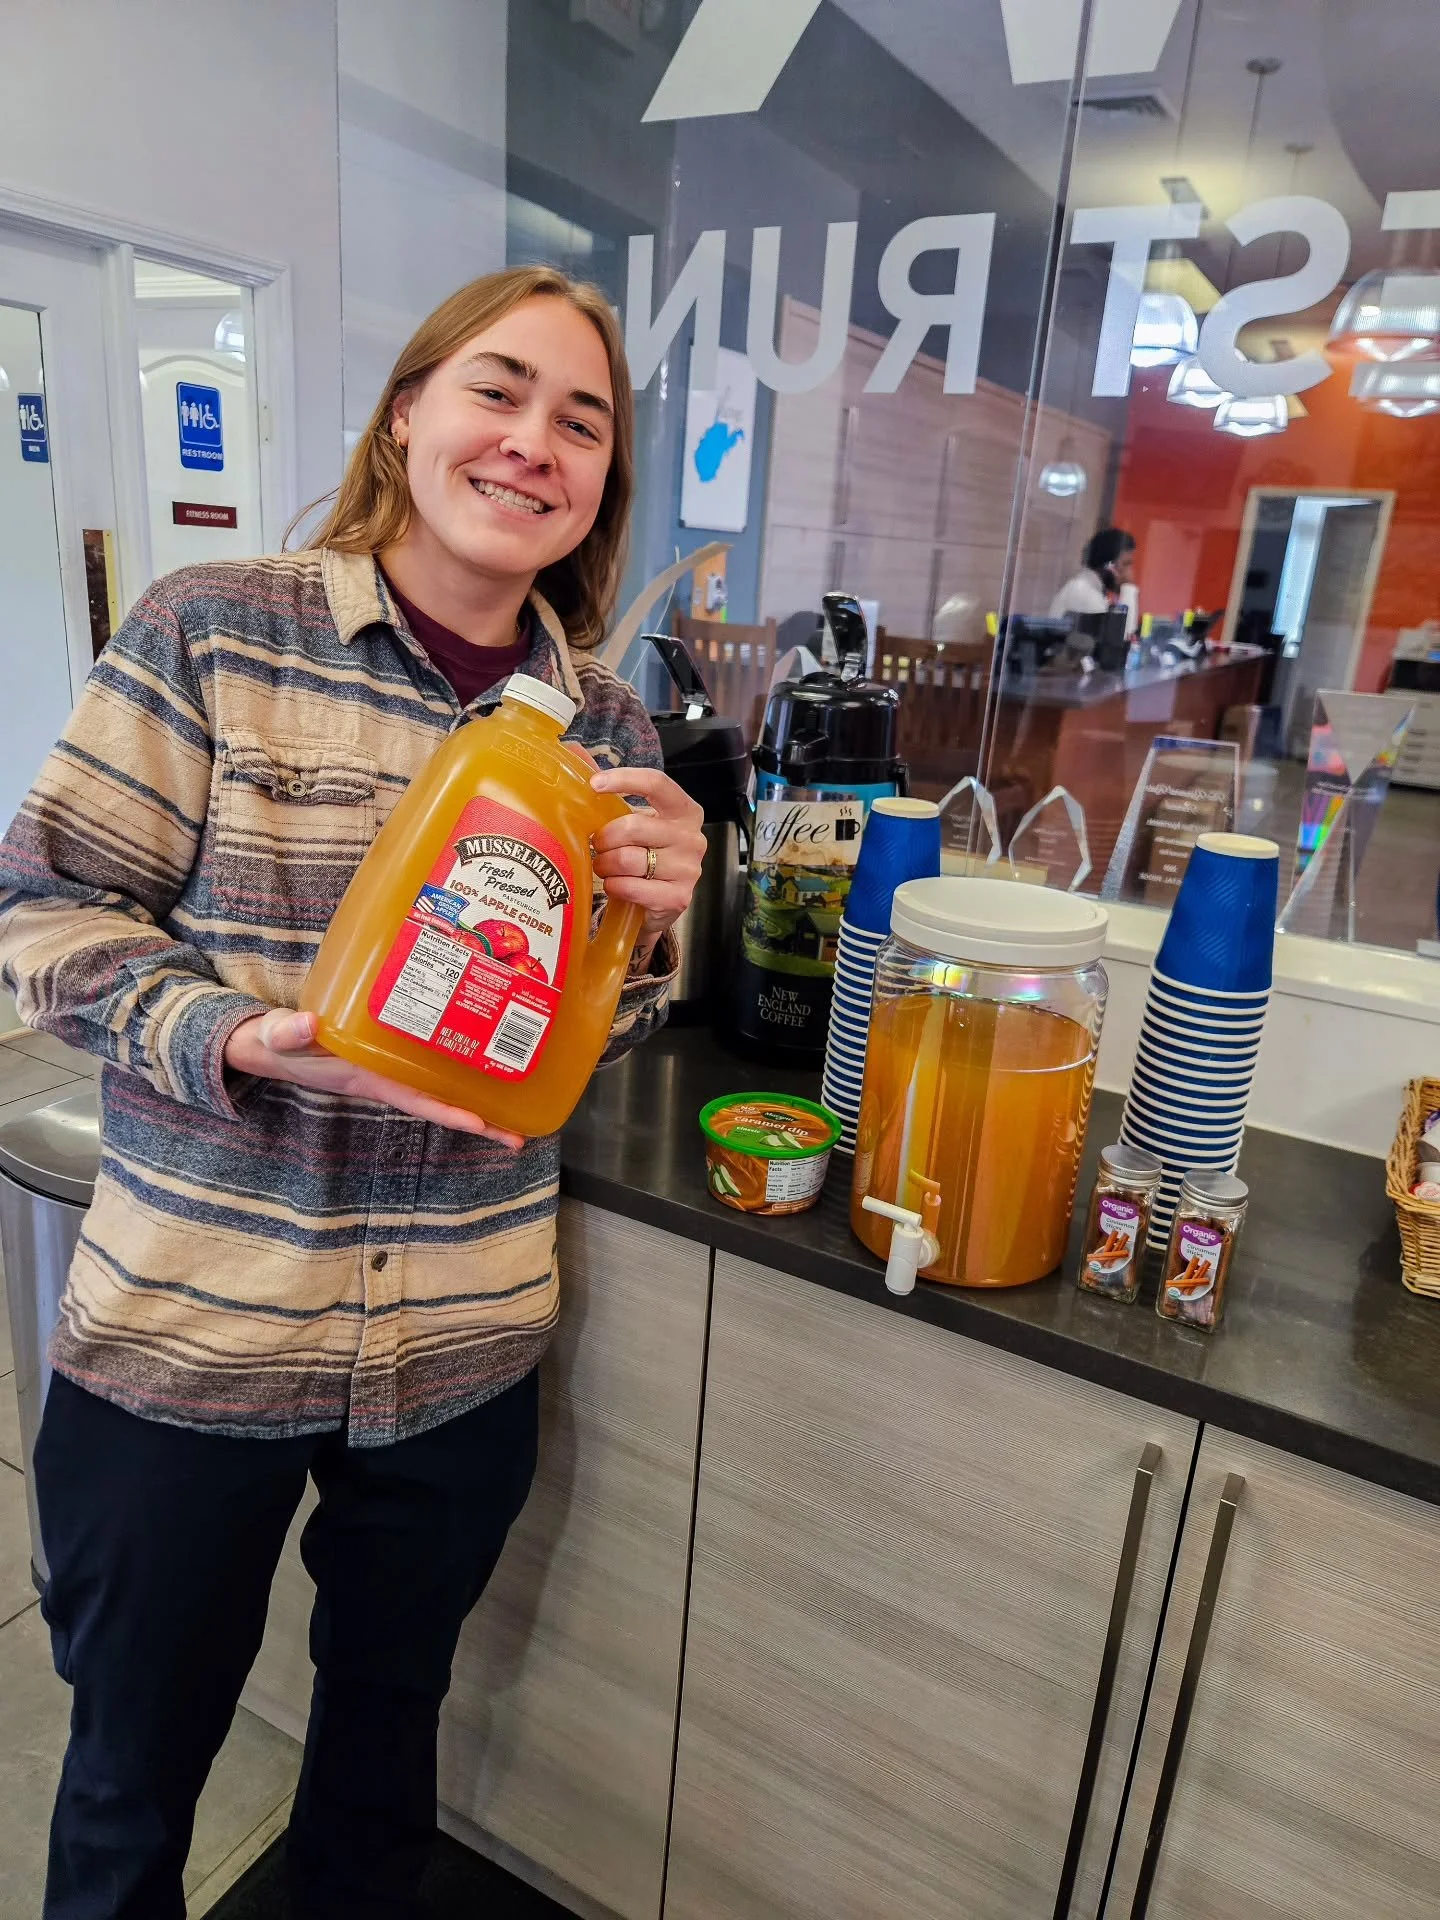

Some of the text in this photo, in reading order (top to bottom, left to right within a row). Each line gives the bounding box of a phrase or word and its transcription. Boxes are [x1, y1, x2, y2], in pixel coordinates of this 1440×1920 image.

[181, 448, 225, 462] RESTROOM
[185, 509, 230, 521] FITNESS ROOM
[755, 804, 830, 858] coffee
[478, 861, 515, 880] Fresh
[484, 876, 539, 899] Pressed
[431, 893, 462, 910] AMERICAN
[438, 901, 460, 914] GROWN
[449, 879, 554, 937] 100% APPLE CIDER
[502, 893, 541, 915] PASTEURIZED
[435, 906, 455, 918] APPLES
[421, 930, 470, 957] Nutrition Facts
[410, 953, 435, 969] Calories
[444, 967, 460, 980] 120
[771, 986, 800, 1003] NEW
[757, 993, 812, 1017] ENGLAND
[759, 1007, 807, 1028] COFFEE
[440, 1026, 453, 1038] NET
[453, 1031, 465, 1043] 128
[734, 1115, 809, 1137] caramel dip
[736, 1126, 761, 1134] classic
[1101, 1200, 1135, 1216] Organic
[1105, 1217, 1135, 1231] Cinnamon
[1105, 1222, 1122, 1231] Sticks
[1182, 1224, 1217, 1242] Organic
[1186, 1243, 1217, 1257] Cinnamon
[1186, 1249, 1204, 1258] Sticks
